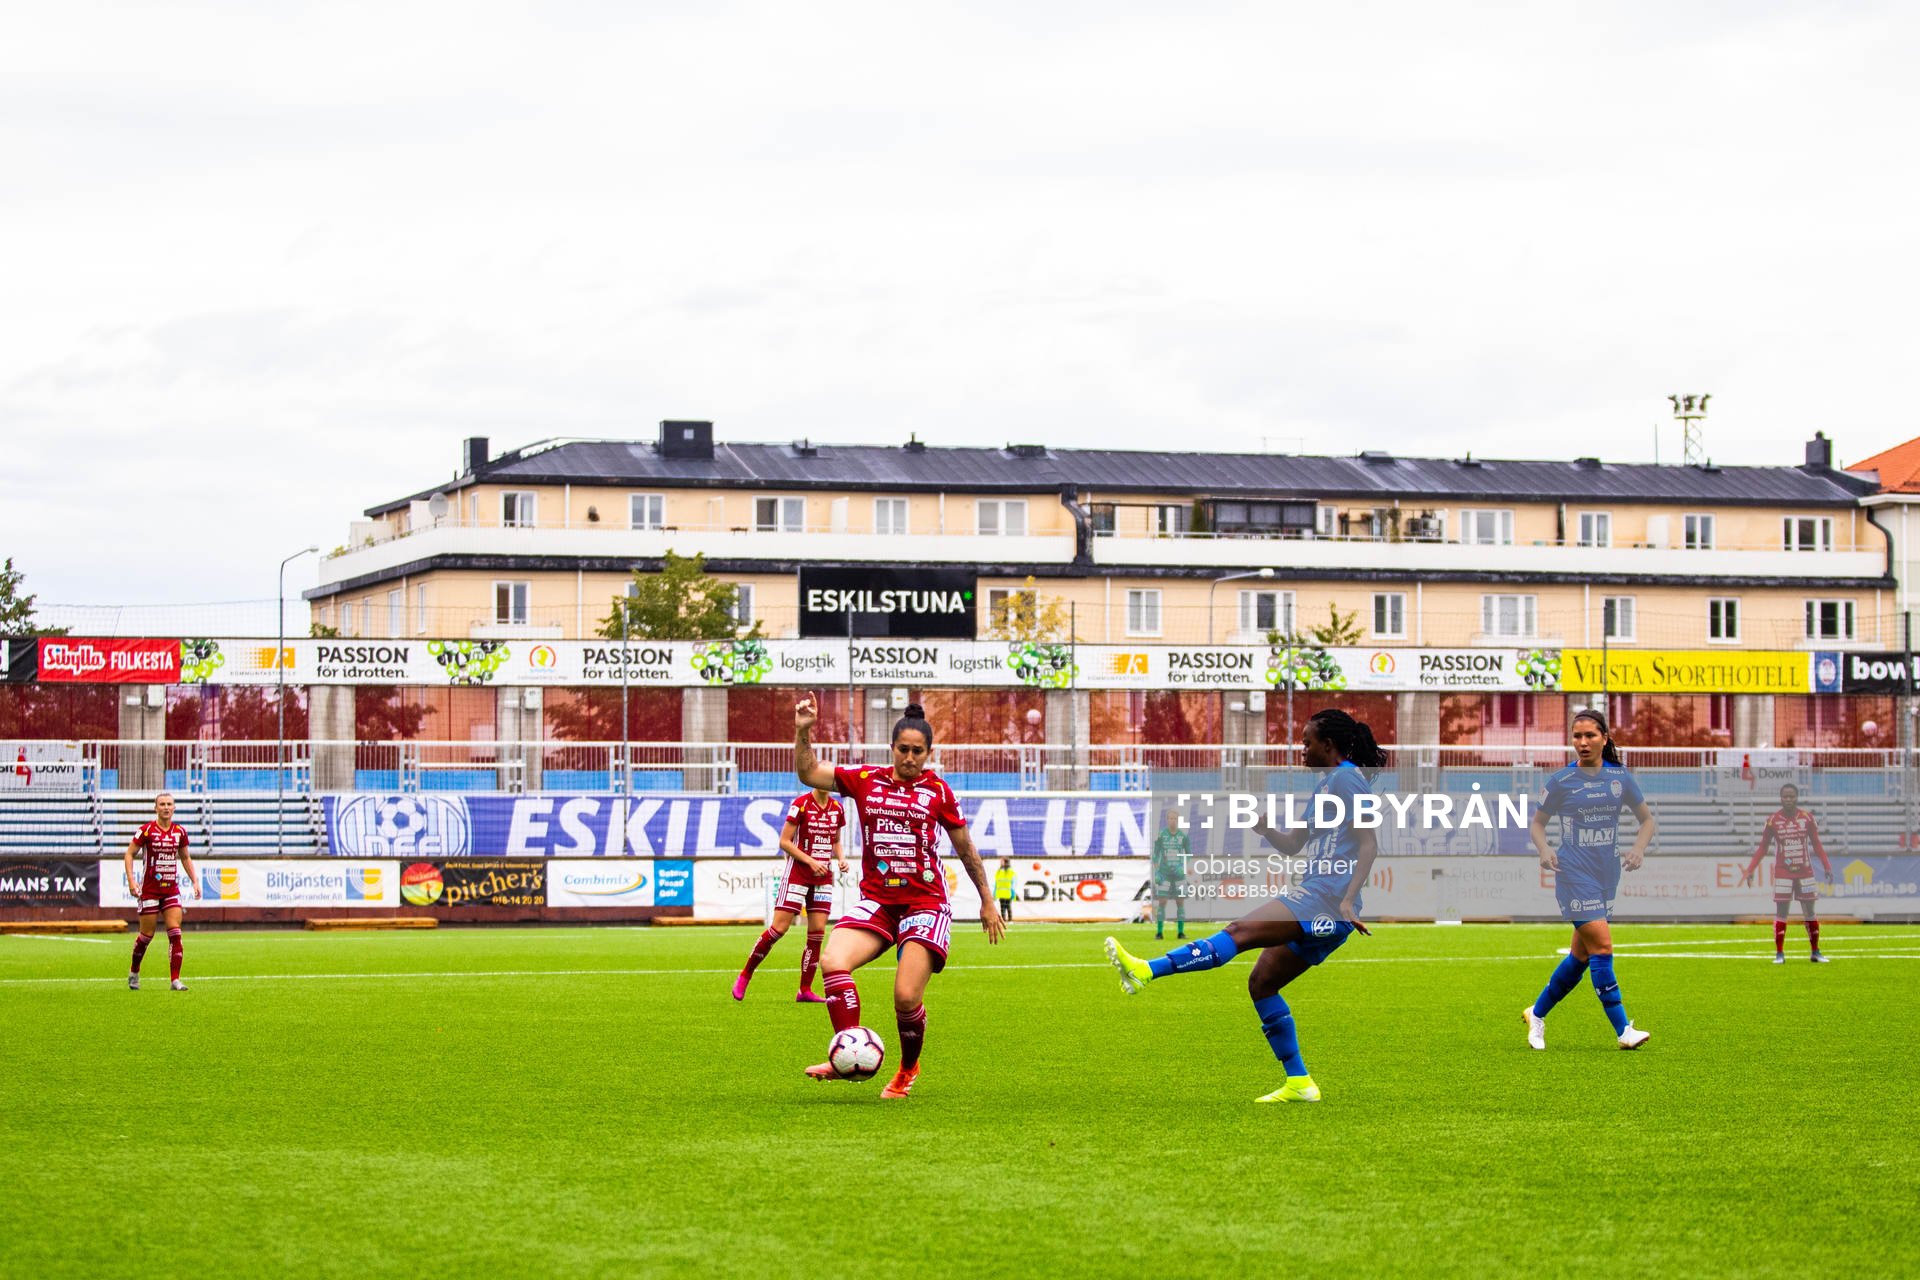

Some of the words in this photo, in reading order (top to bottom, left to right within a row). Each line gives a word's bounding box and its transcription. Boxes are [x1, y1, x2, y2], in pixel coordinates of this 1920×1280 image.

[807, 589, 965, 613] ESKILSTUNA
[44, 644, 105, 676] Sibylla
[110, 651, 174, 670] FOLKESTA
[316, 647, 410, 663] PASSION
[583, 648, 673, 665] PASSION
[781, 651, 835, 673] logistik
[849, 646, 938, 664] PASSION
[950, 653, 1002, 672] logistik
[1168, 652, 1254, 669] PASSION
[1420, 655, 1504, 671] PASSION
[317, 665, 339, 678] för
[343, 665, 409, 678] idrotten.
[583, 667, 605, 679] för
[871, 668, 938, 679] Eskilstuna.
[1168, 671, 1187, 683] för
[1192, 671, 1253, 684] idrotten.
[1420, 673, 1439, 686] för
[1443, 673, 1503, 686] idrotten.
[1758, 768, 1793, 779] Down
[865, 805, 905, 818] Sparbanken
[907, 809, 927, 820] Nord
[876, 818, 912, 834] Piteå
[1579, 828, 1615, 843] MAXI
[54, 877, 87, 892] TAK
[266, 872, 343, 892] Biltjänsten
[564, 873, 630, 886] Combimix
[522, 896, 533, 905] 20
[534, 896, 545, 905] 20
[915, 926, 930, 938] 22
